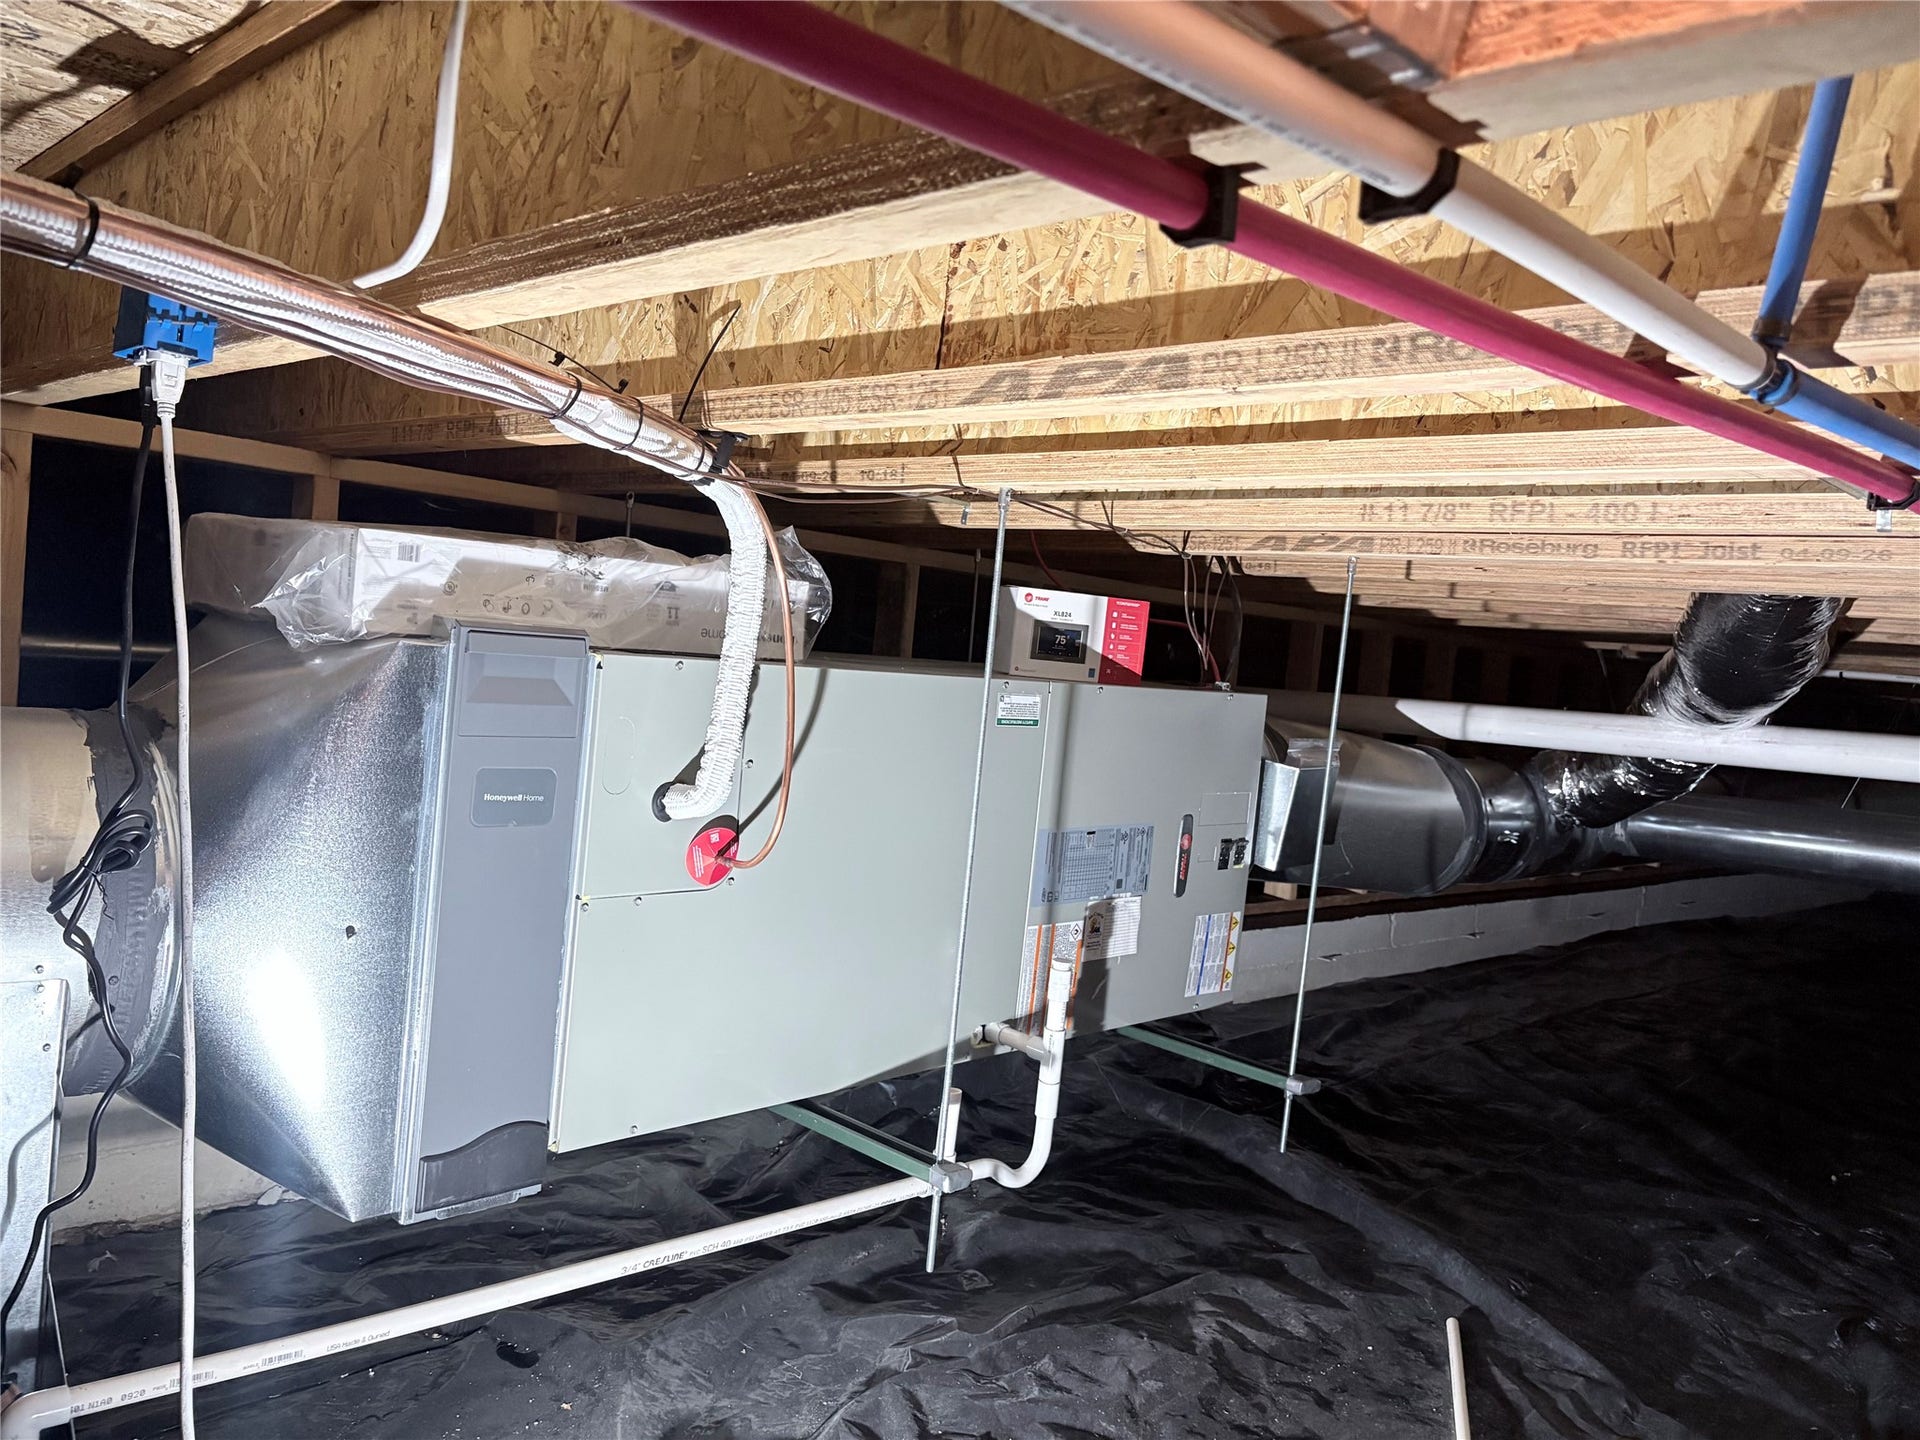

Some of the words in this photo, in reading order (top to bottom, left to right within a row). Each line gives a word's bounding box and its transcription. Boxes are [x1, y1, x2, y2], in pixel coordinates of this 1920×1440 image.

[956, 352, 1189, 406] APA
[1245, 535, 1374, 552] APA
[1479, 539, 1599, 558] Roseburg
[1053, 610, 1072, 618] XL824
[1055, 635, 1066, 645] 75
[483, 793, 522, 803] Honeywell
[702, 1243, 720, 1254] SCH
[721, 1239, 732, 1249] 40
[327, 1344, 340, 1352] USA
